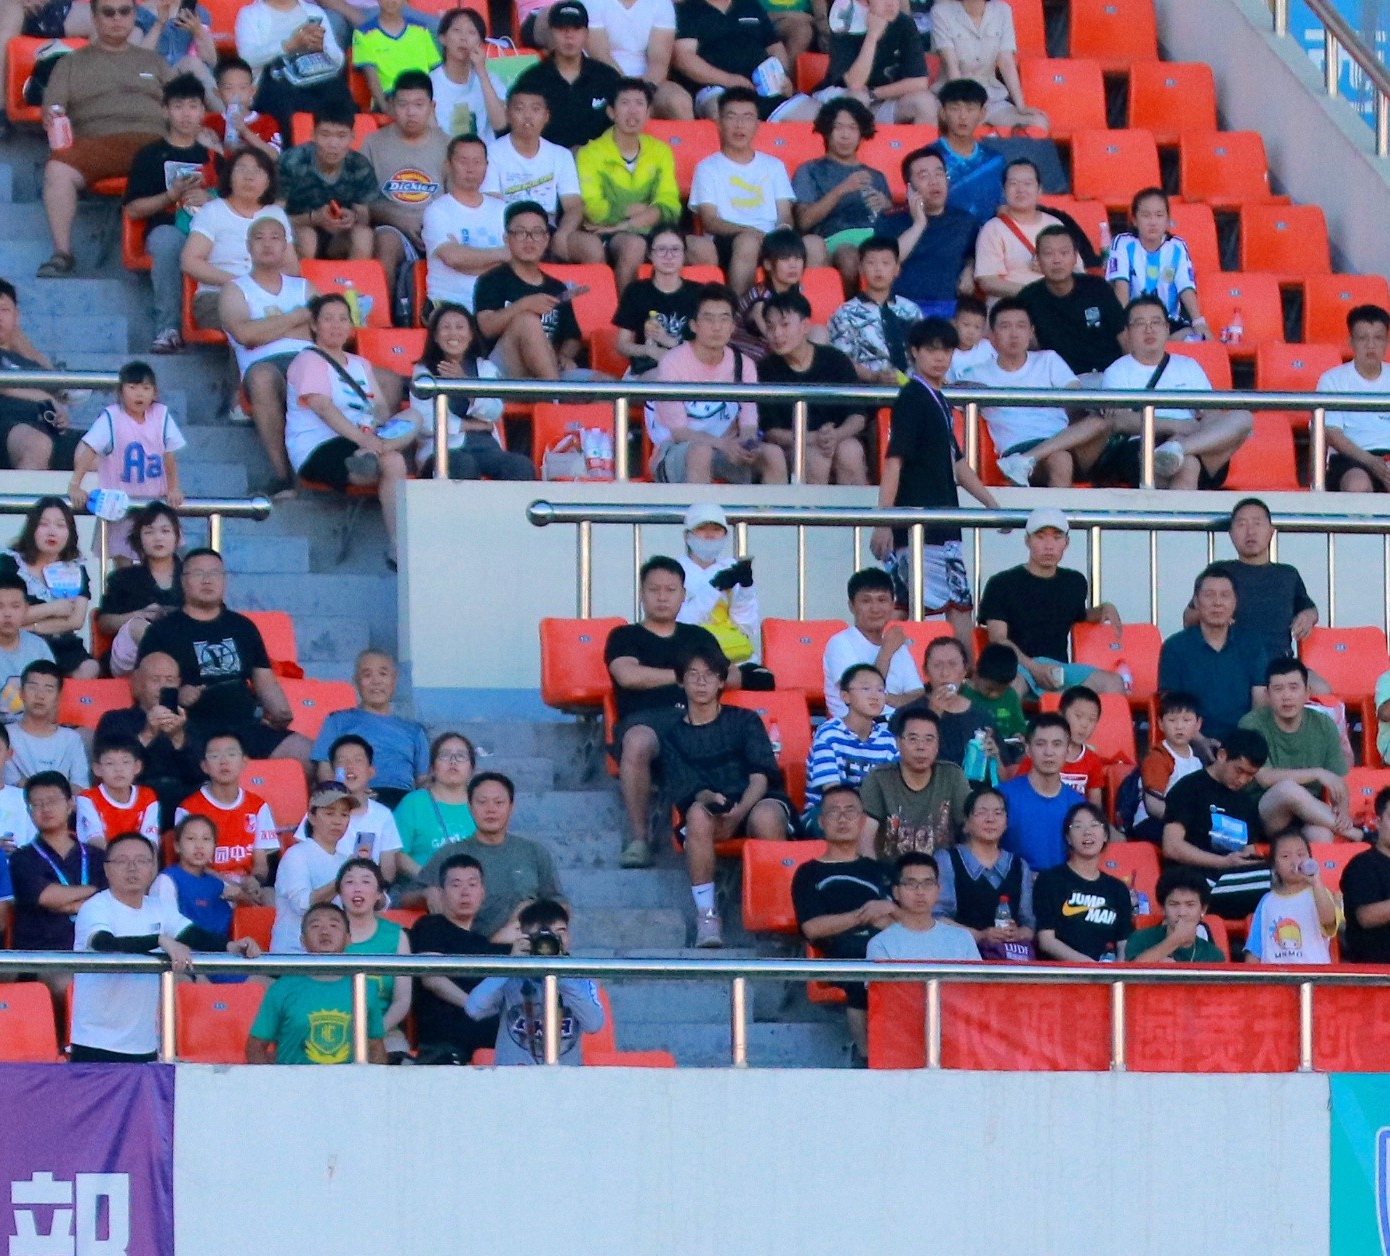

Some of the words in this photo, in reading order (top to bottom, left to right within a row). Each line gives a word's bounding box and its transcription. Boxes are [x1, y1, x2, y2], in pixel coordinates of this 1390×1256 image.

[389, 182, 437, 194] Dickies
[120, 441, 162, 484] Aa
[1068, 892, 1106, 908] JUMP
[1084, 908, 1117, 926] MAN
